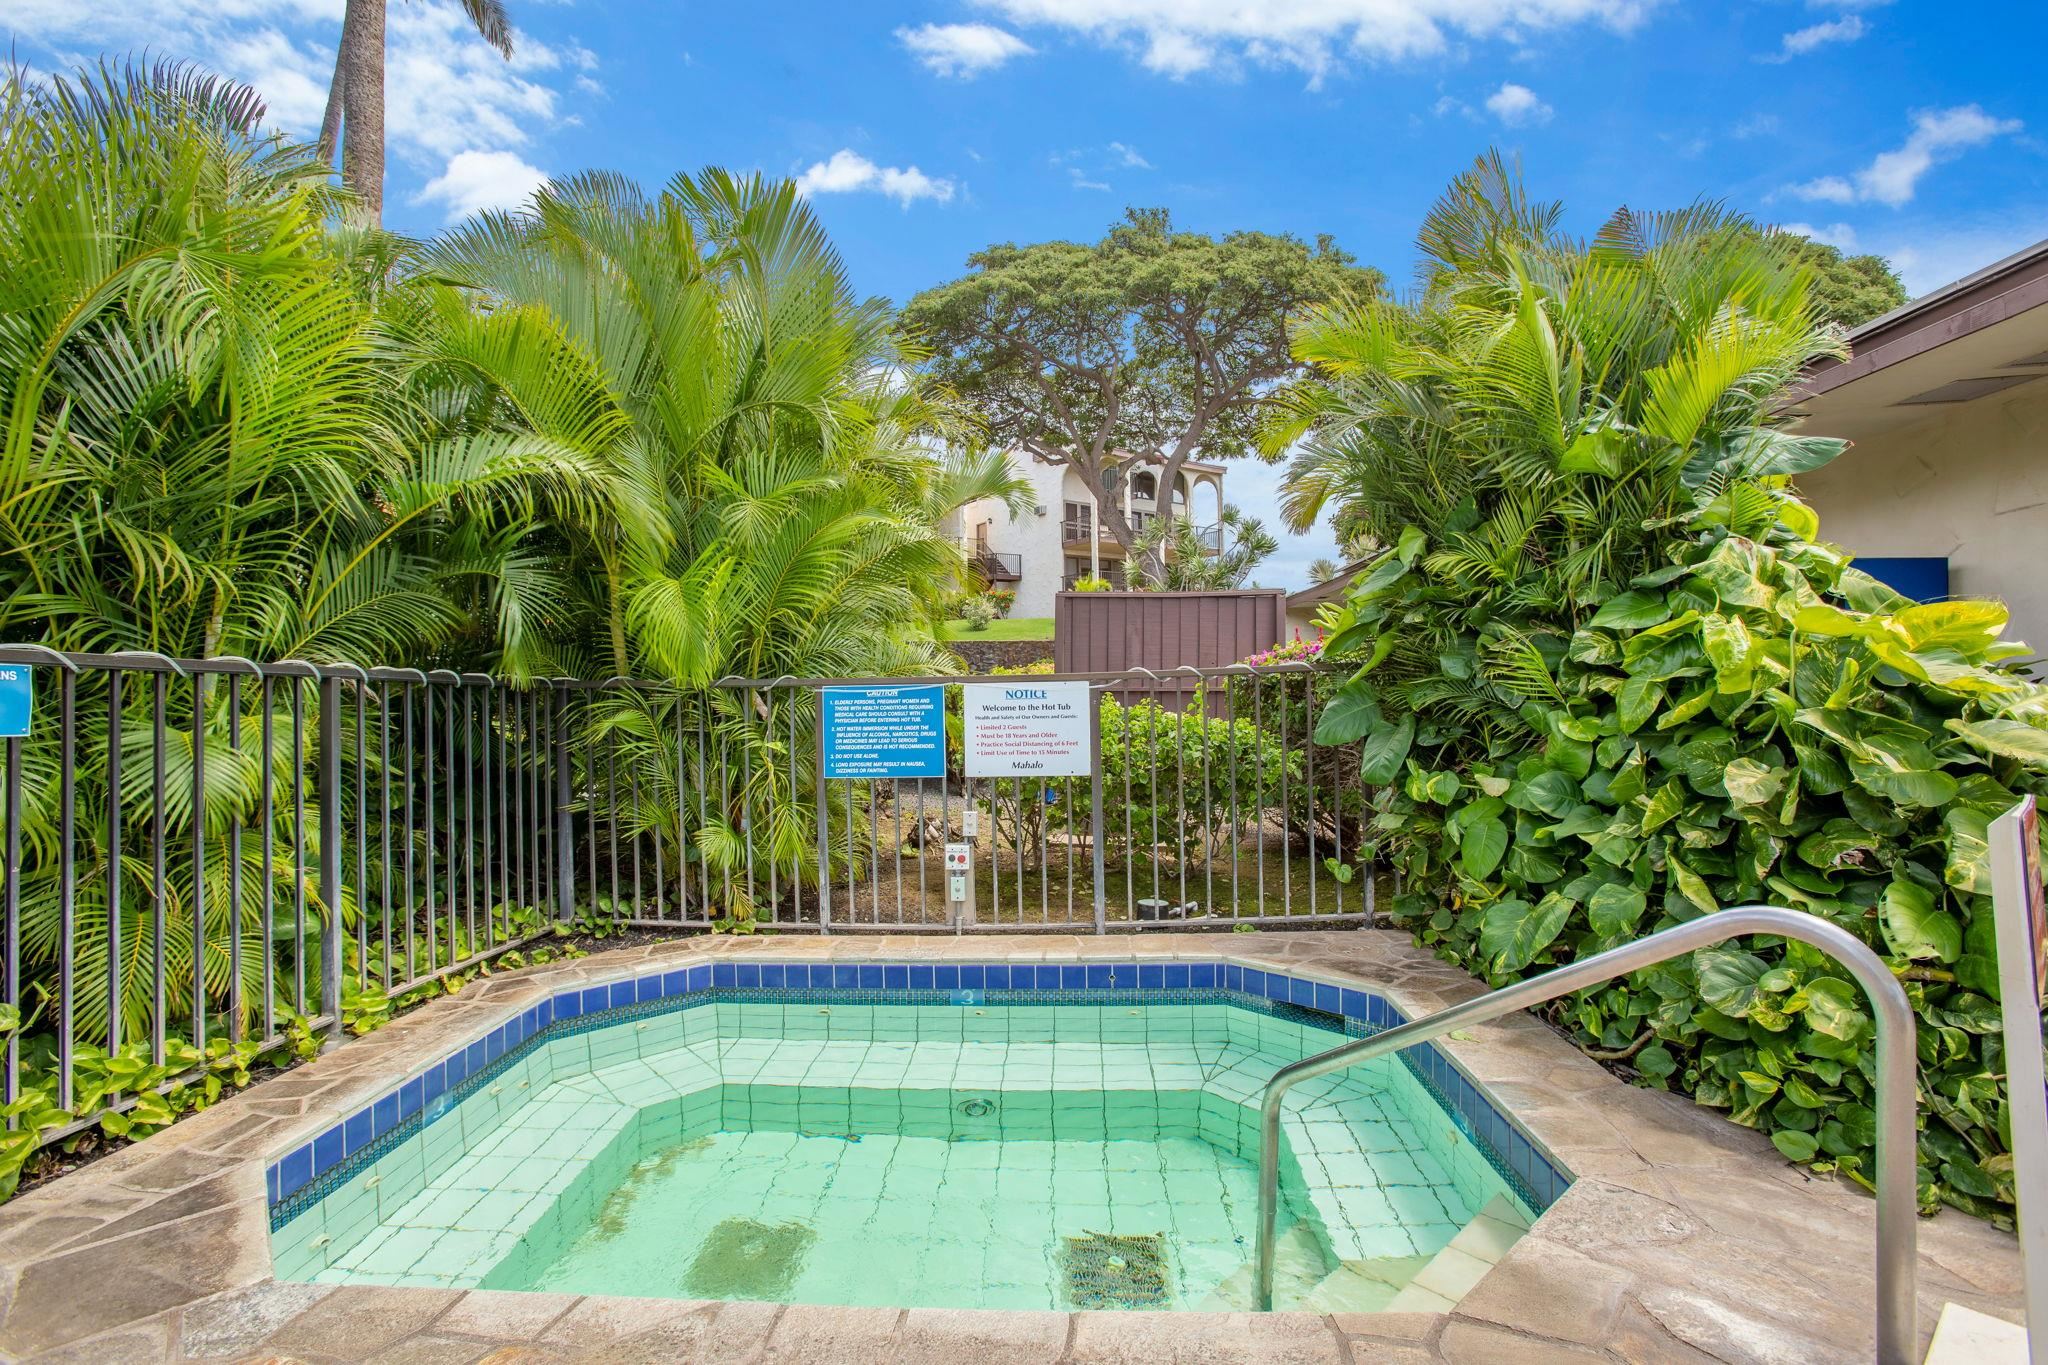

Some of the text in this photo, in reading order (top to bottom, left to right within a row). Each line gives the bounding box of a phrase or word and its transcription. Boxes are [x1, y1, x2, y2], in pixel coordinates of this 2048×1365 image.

[0, 670, 17, 680] NS
[1006, 690, 1047, 699] NOTICE
[1012, 760, 1043, 769] Mahalo
[961, 990, 974, 1004] 3
